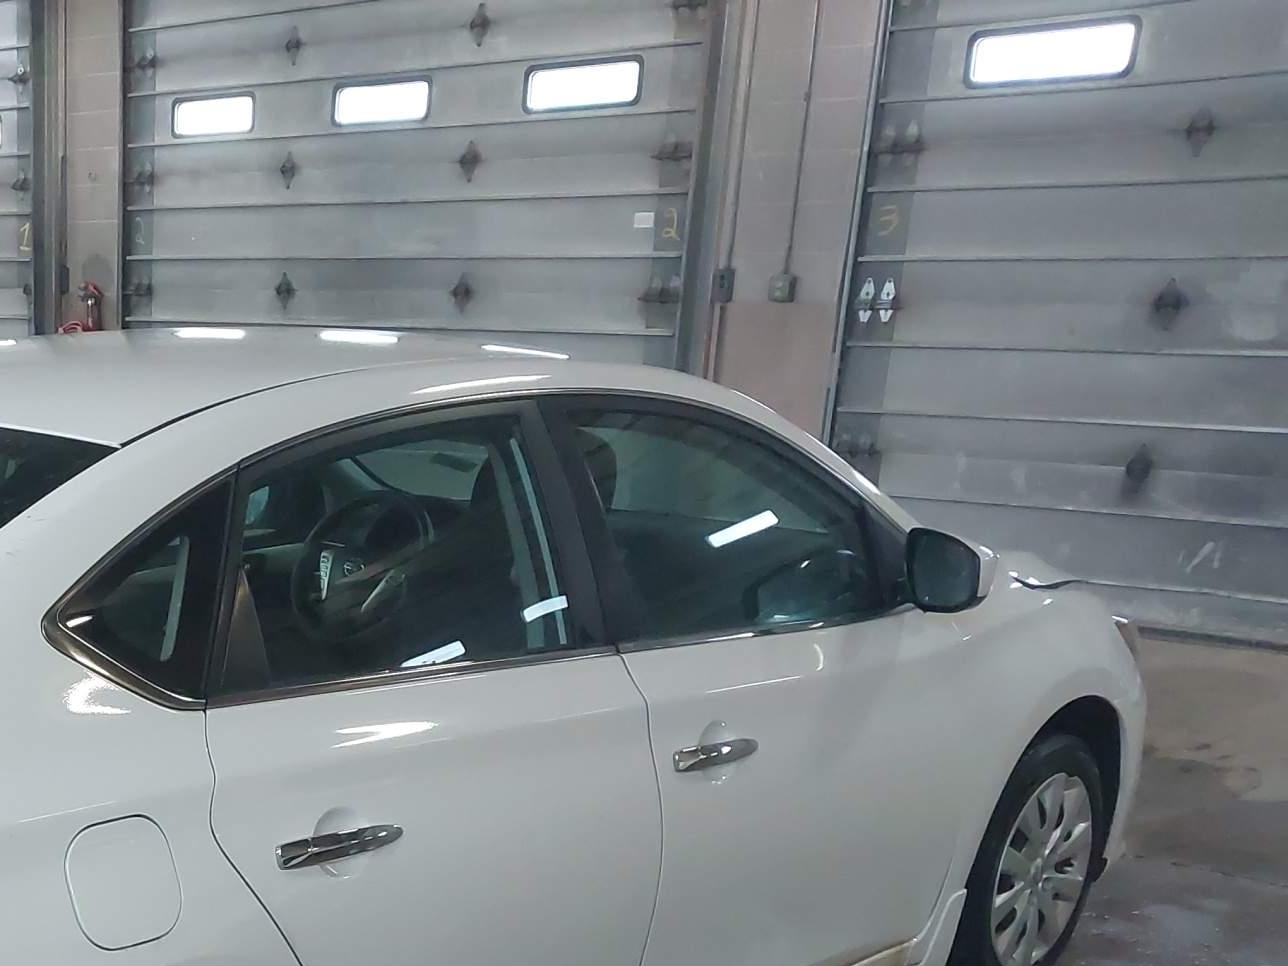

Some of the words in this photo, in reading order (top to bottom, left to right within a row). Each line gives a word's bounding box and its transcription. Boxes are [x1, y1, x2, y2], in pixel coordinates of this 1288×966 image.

[18, 222, 32, 251] 1
[662, 207, 681, 241] 2
[877, 204, 899, 237] 3
